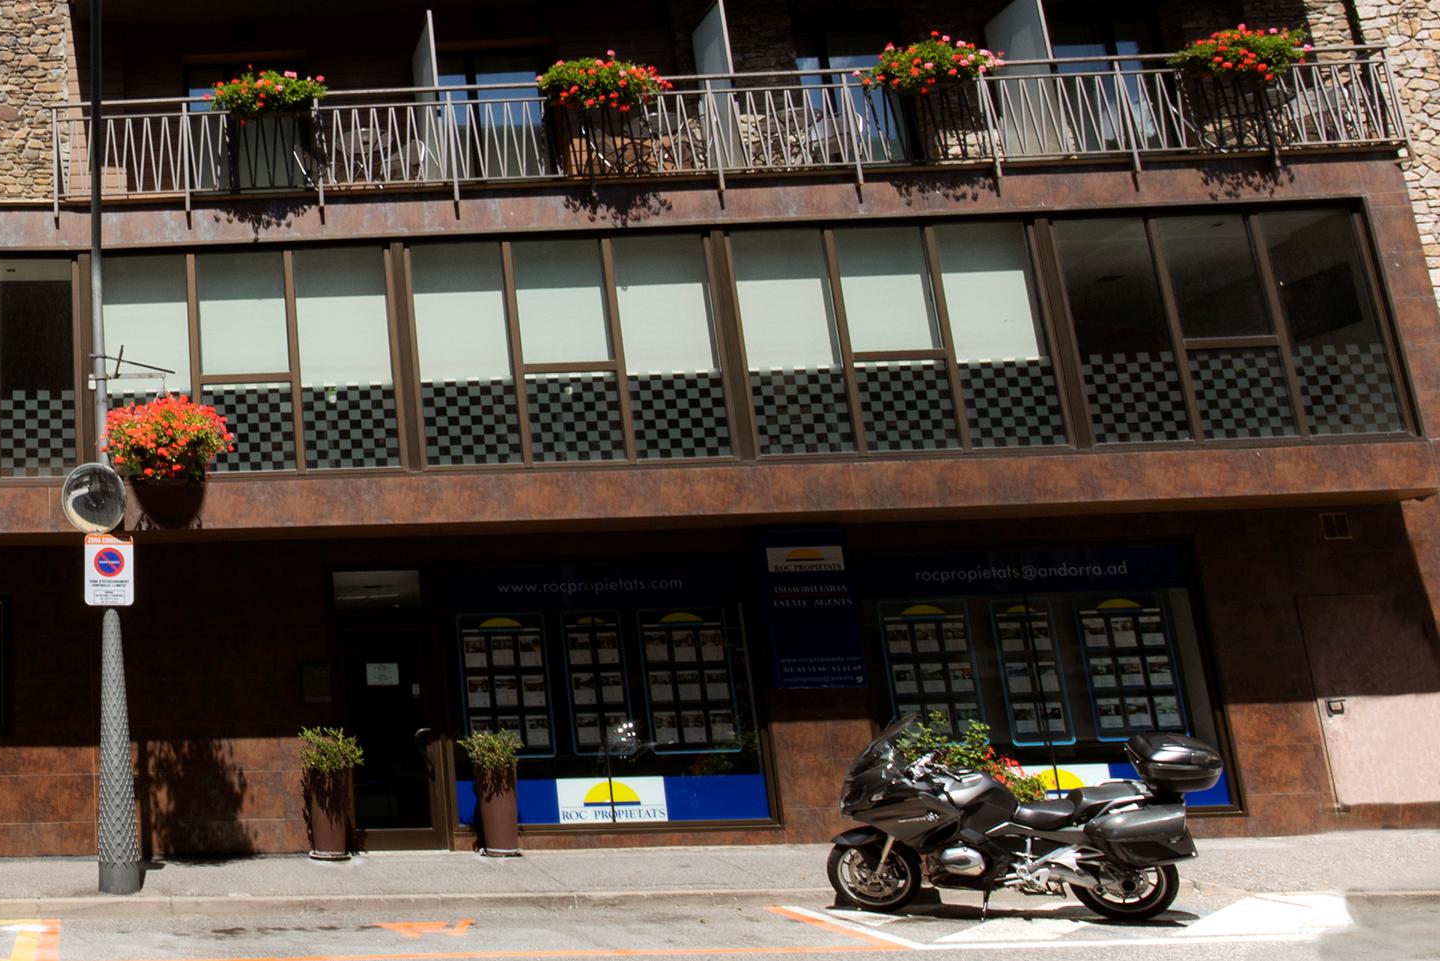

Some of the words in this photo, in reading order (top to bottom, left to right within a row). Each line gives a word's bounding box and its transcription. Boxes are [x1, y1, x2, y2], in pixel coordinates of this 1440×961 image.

[914, 559, 1128, 584] rocpropietats@andorra.ad
[562, 810, 587, 821] ROC
[594, 808, 666, 820] PROPIETATS
